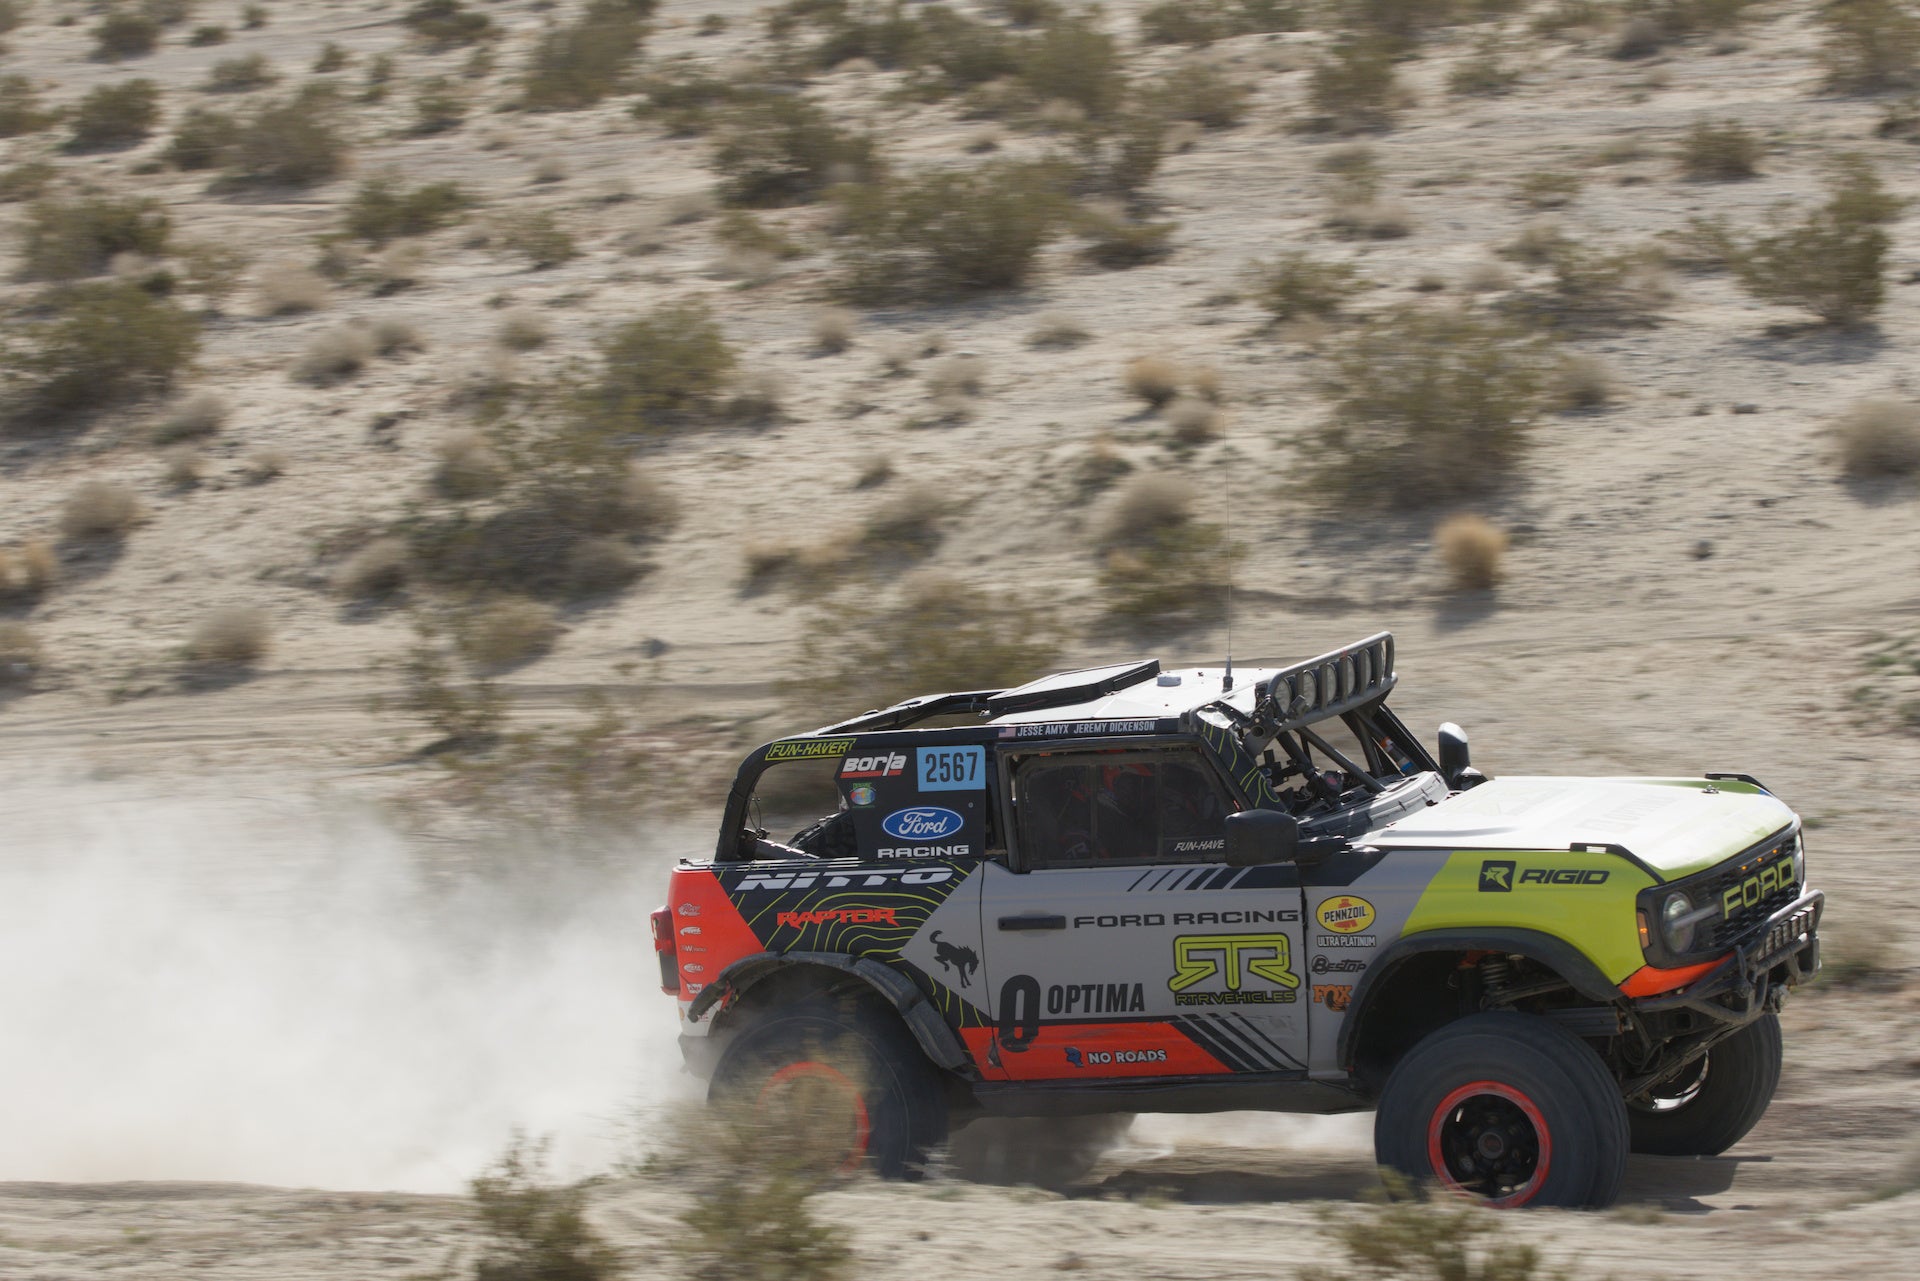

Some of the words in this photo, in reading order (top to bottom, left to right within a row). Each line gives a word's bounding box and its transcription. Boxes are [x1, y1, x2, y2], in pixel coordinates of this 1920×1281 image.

[1017, 726, 1044, 737] JESSE
[1045, 724, 1069, 735] AMYX
[1073, 722, 1107, 734] JEREMY
[1109, 721, 1155, 732] DICKENSON
[769, 741, 849, 757] FUN-HAVER
[925, 752, 978, 783] 2567
[898, 811, 948, 834] Ford
[877, 845, 970, 859] RACING
[1174, 839, 1225, 852] FUN-HAVE
[734, 867, 953, 891] NITTO
[1518, 869, 1610, 885] RIGID
[1722, 856, 1795, 920] FORD
[776, 908, 900, 931] RAPTOR
[1073, 912, 1166, 929] FORD
[1173, 909, 1299, 926] RACING
[1324, 905, 1366, 923] PENNZOIL
[1317, 935, 1339, 947] ULTRA
[1340, 935, 1376, 947] PLATINUM
[1047, 983, 1145, 1014] OPTIMA
[1312, 985, 1352, 1012] FOX
[1088, 1051, 1111, 1064] NO
[1115, 1049, 1167, 1063] ROADS
